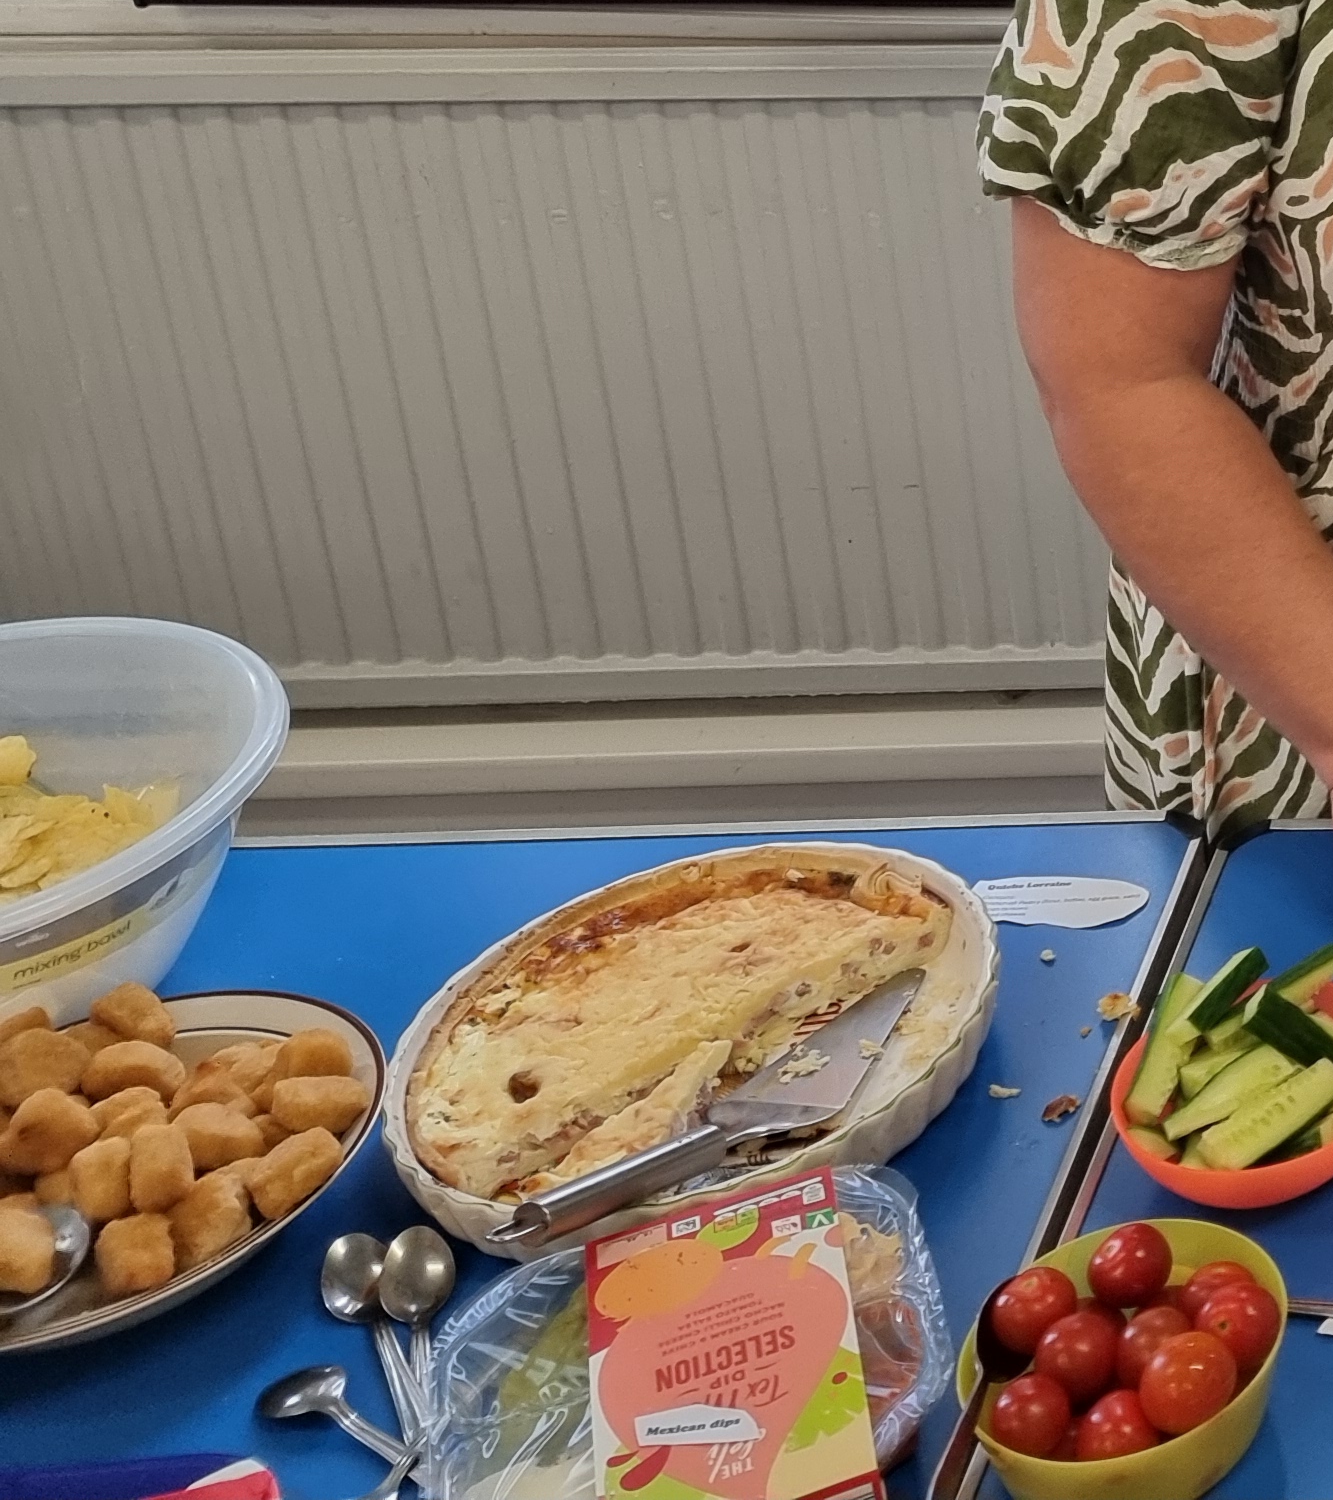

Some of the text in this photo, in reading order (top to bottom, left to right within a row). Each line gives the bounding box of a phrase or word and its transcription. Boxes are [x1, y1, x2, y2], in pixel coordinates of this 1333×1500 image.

[12, 945, 82, 981] mixing
[86, 919, 132, 952] bowl
[654, 1324, 796, 1393] SELECTION
[709, 1369, 746, 1390] DIP
[744, 1374, 790, 1407] Tex
[645, 1416, 741, 1437] Mexican dips
[720, 1457, 755, 1480] THE
